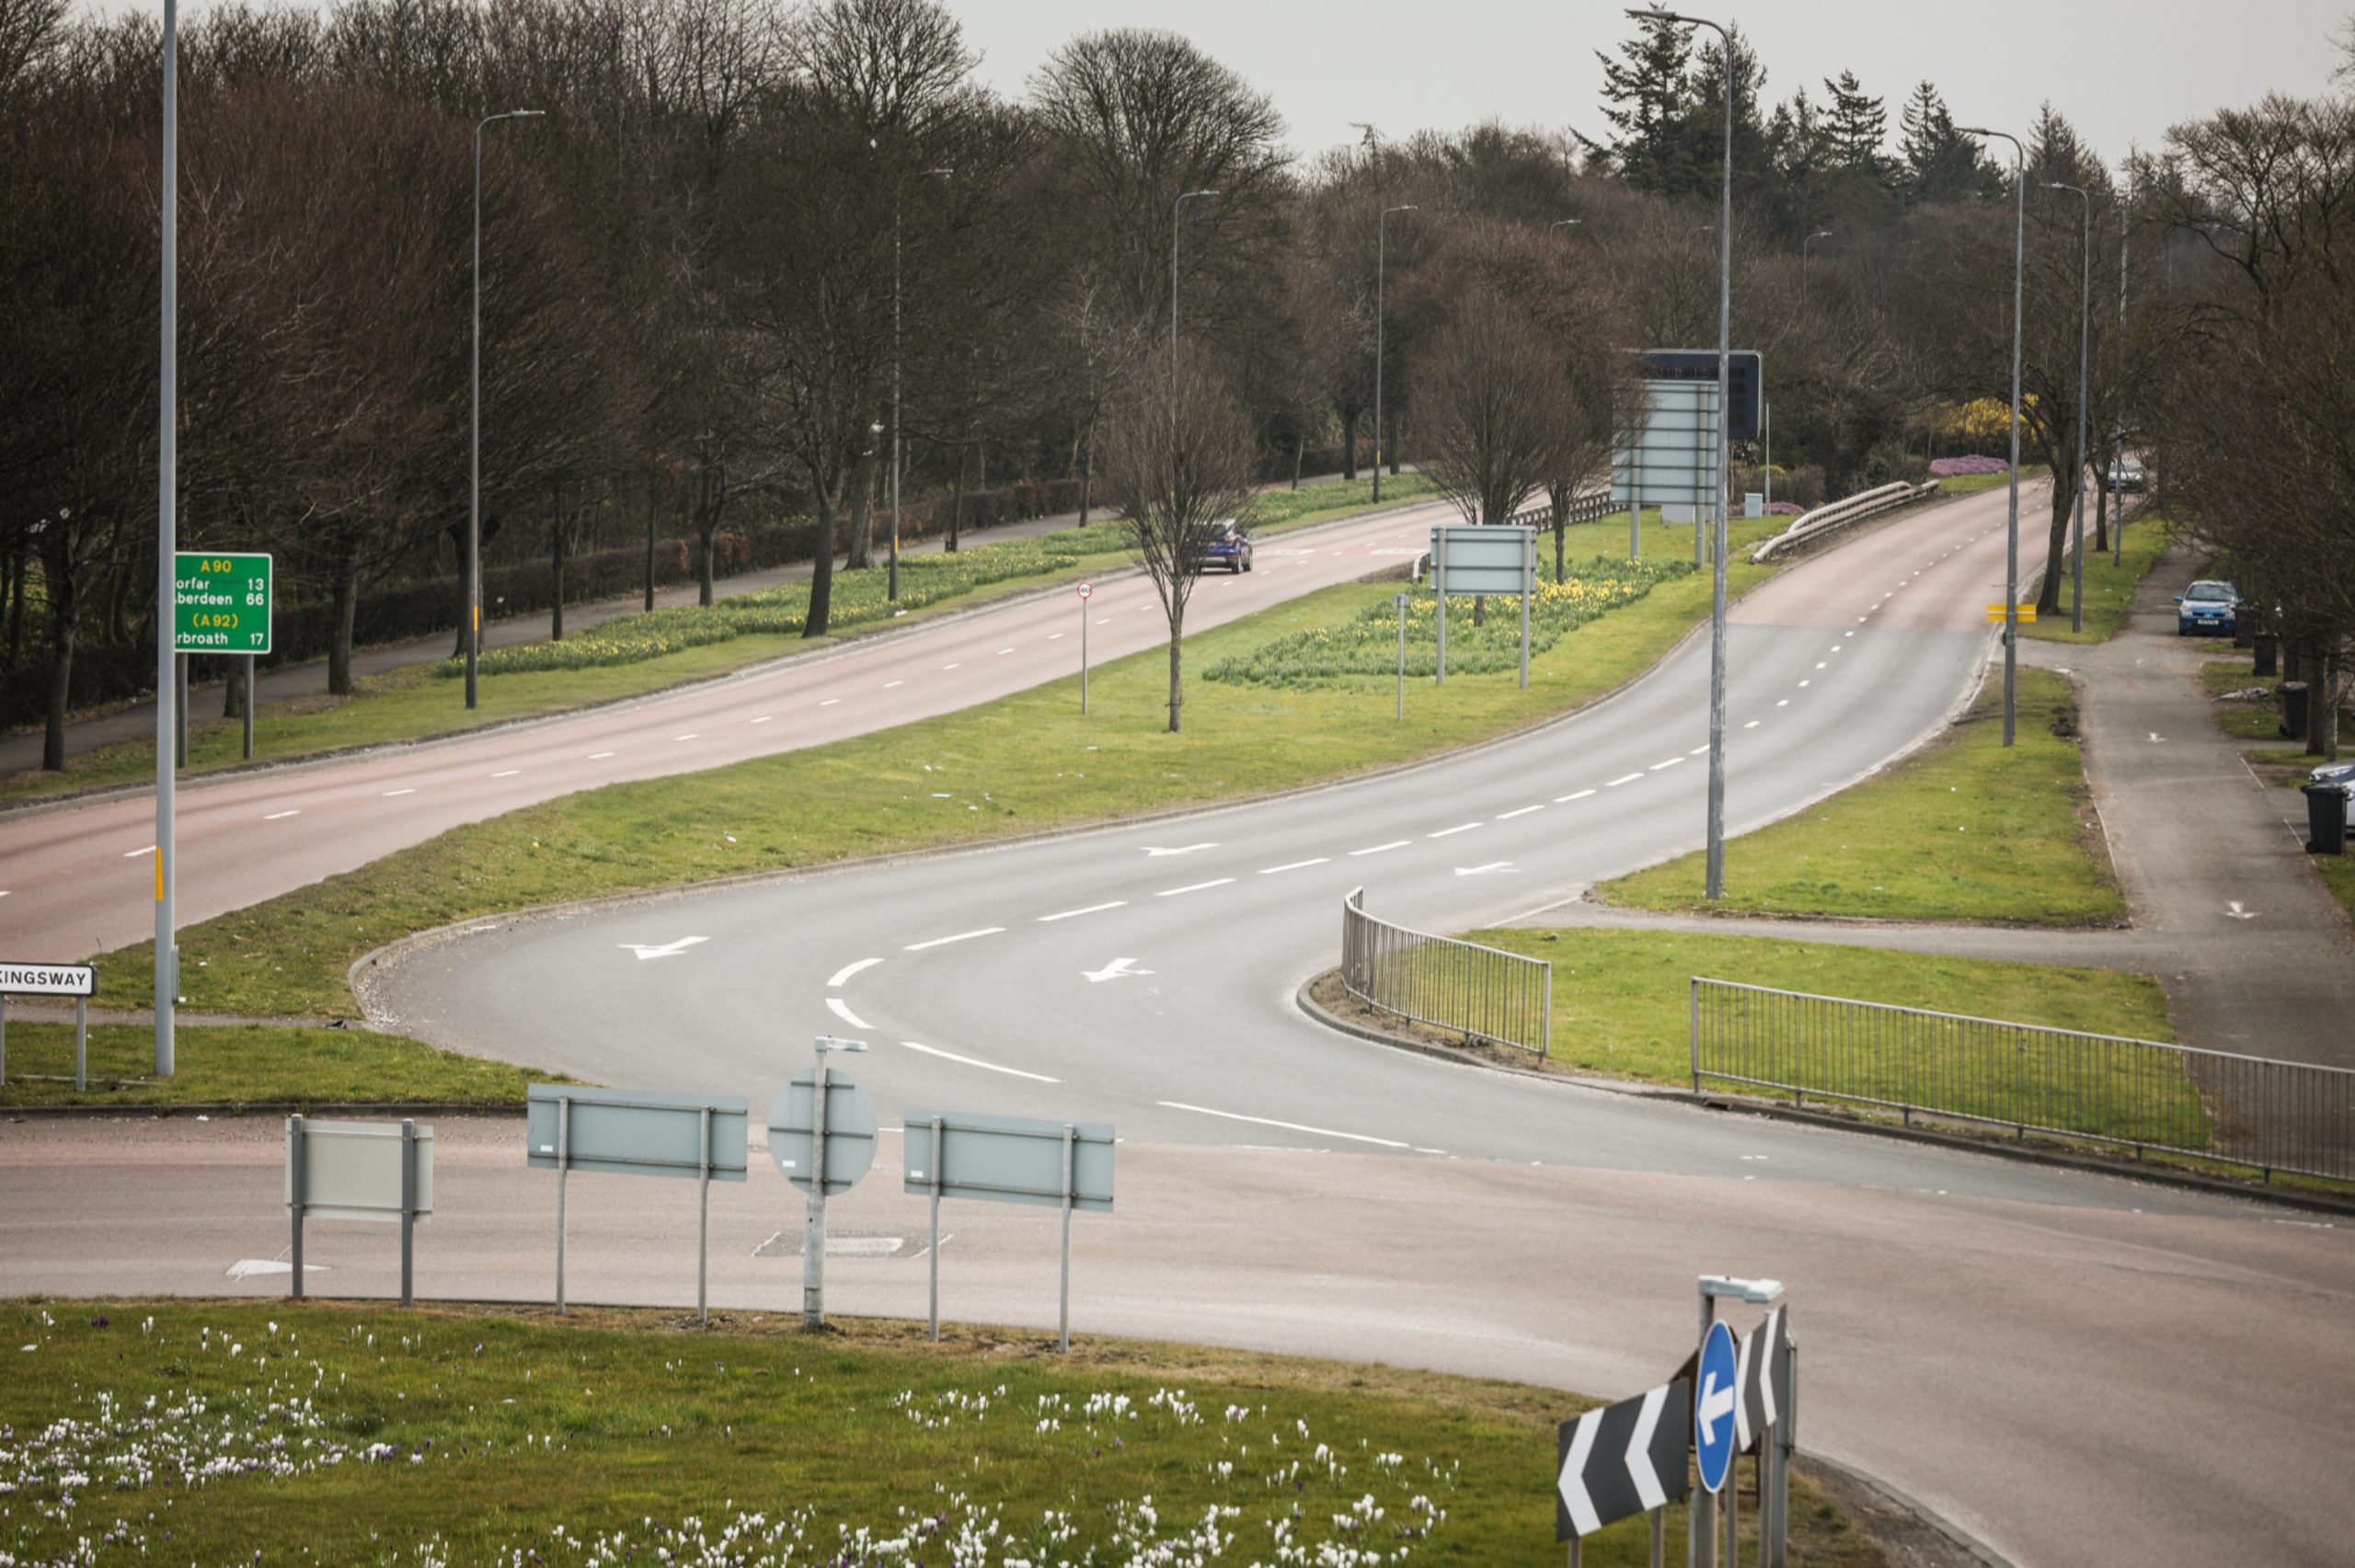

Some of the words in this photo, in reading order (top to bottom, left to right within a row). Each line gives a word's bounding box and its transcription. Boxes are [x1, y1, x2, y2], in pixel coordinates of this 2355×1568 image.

[175, 577, 210, 589] orfar
[247, 578, 264, 591] 13
[175, 592, 233, 605] berdeen
[246, 593, 264, 606] 66
[175, 632, 228, 645] rbroath
[250, 633, 264, 646] 17
